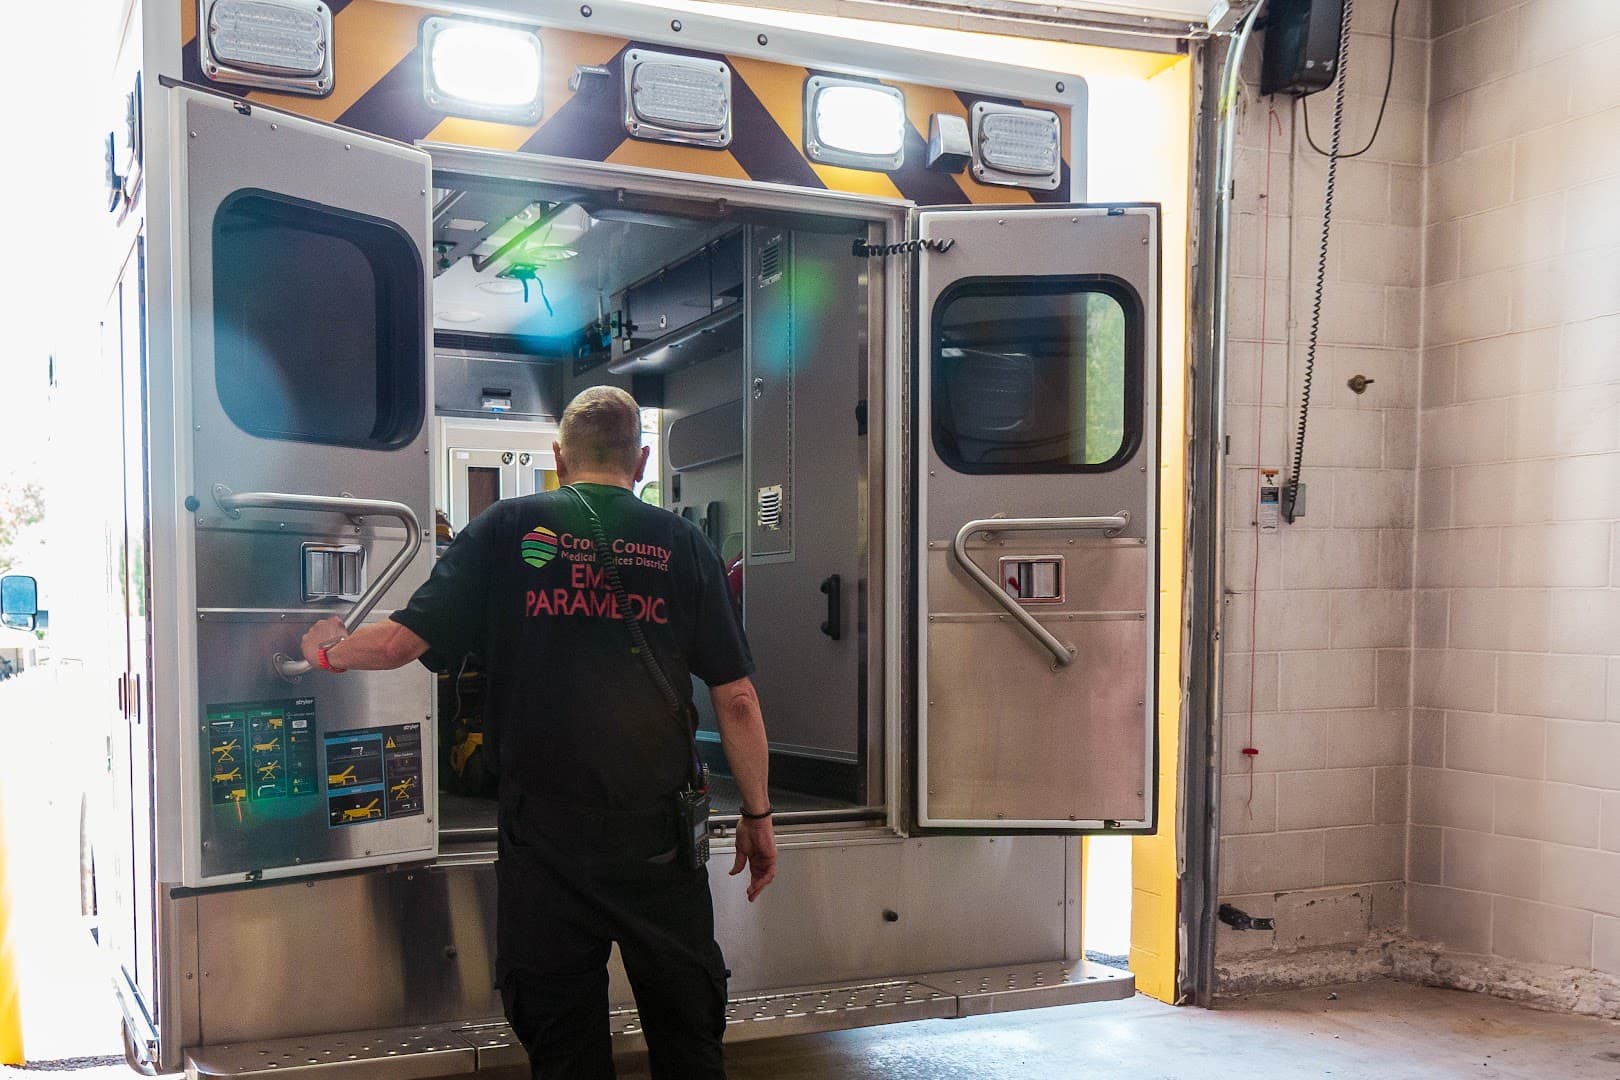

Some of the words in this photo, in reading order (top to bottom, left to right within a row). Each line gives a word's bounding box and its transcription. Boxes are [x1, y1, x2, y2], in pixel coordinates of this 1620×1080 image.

[560, 532, 597, 551] Cro
[611, 538, 672, 563] County
[561, 550, 596, 562] Medical
[635, 556, 669, 572] District
